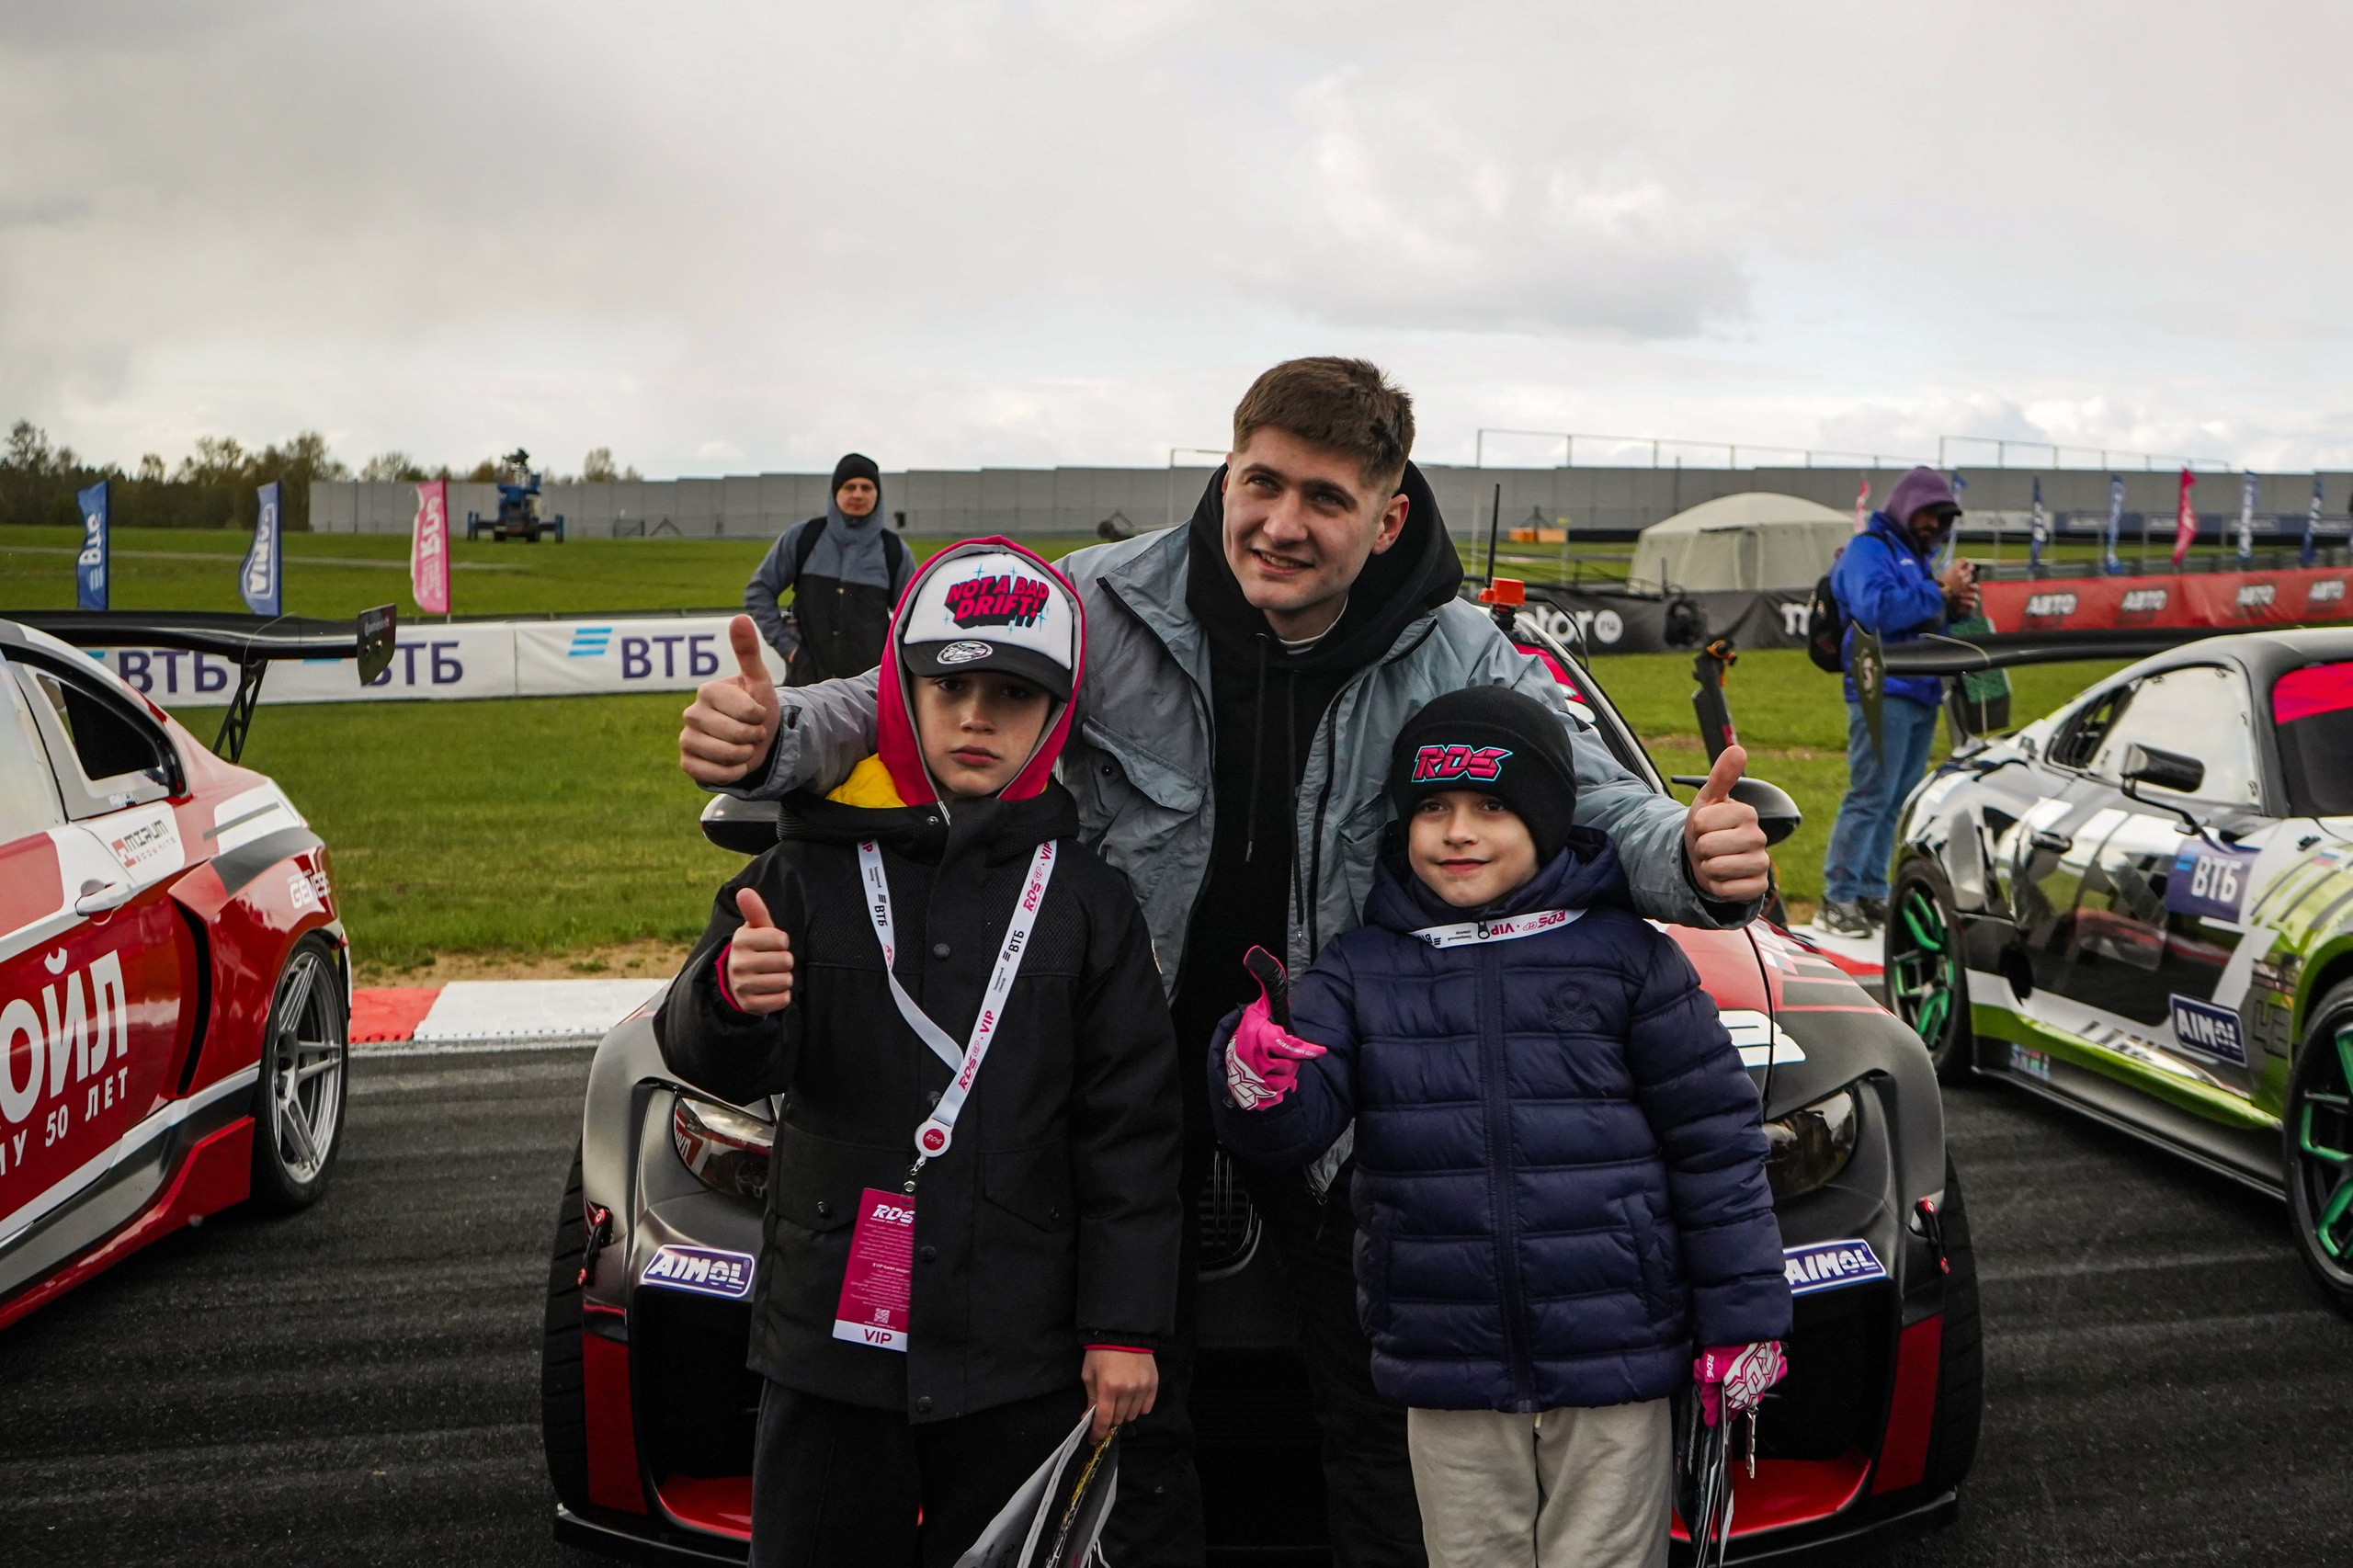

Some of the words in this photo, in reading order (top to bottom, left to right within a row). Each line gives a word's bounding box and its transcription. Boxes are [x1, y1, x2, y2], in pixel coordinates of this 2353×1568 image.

[945, 575, 995, 604] NOT
[992, 575, 1011, 595] A
[1013, 576, 1050, 599] BAD
[953, 594, 1041, 621] DRIFT!
[621, 635, 719, 679] ВТБ
[1412, 745, 1513, 781] RDS
[862, 841, 873, 853] IP
[1023, 878, 1041, 913] RDS
[1040, 841, 1053, 861] VIP
[2190, 855, 2243, 903] ВТБ
[874, 904, 888, 926] ВТБ
[1008, 930, 1025, 953] ВТБ
[1491, 923, 1516, 936] VIP
[958, 1054, 978, 1091] RDS
[979, 1009, 995, 1034] VIP
[45, 1104, 68, 1147] 50
[85, 1065, 129, 1122] ЛЕТ
[925, 1133, 944, 1145] RDS
[872, 1204, 915, 1224] RDS
[647, 1254, 745, 1290] AIMOL
[1784, 1248, 1877, 1286] AIMOL
[864, 1328, 892, 1345] VIP
[1706, 1353, 1715, 1379] RDS
